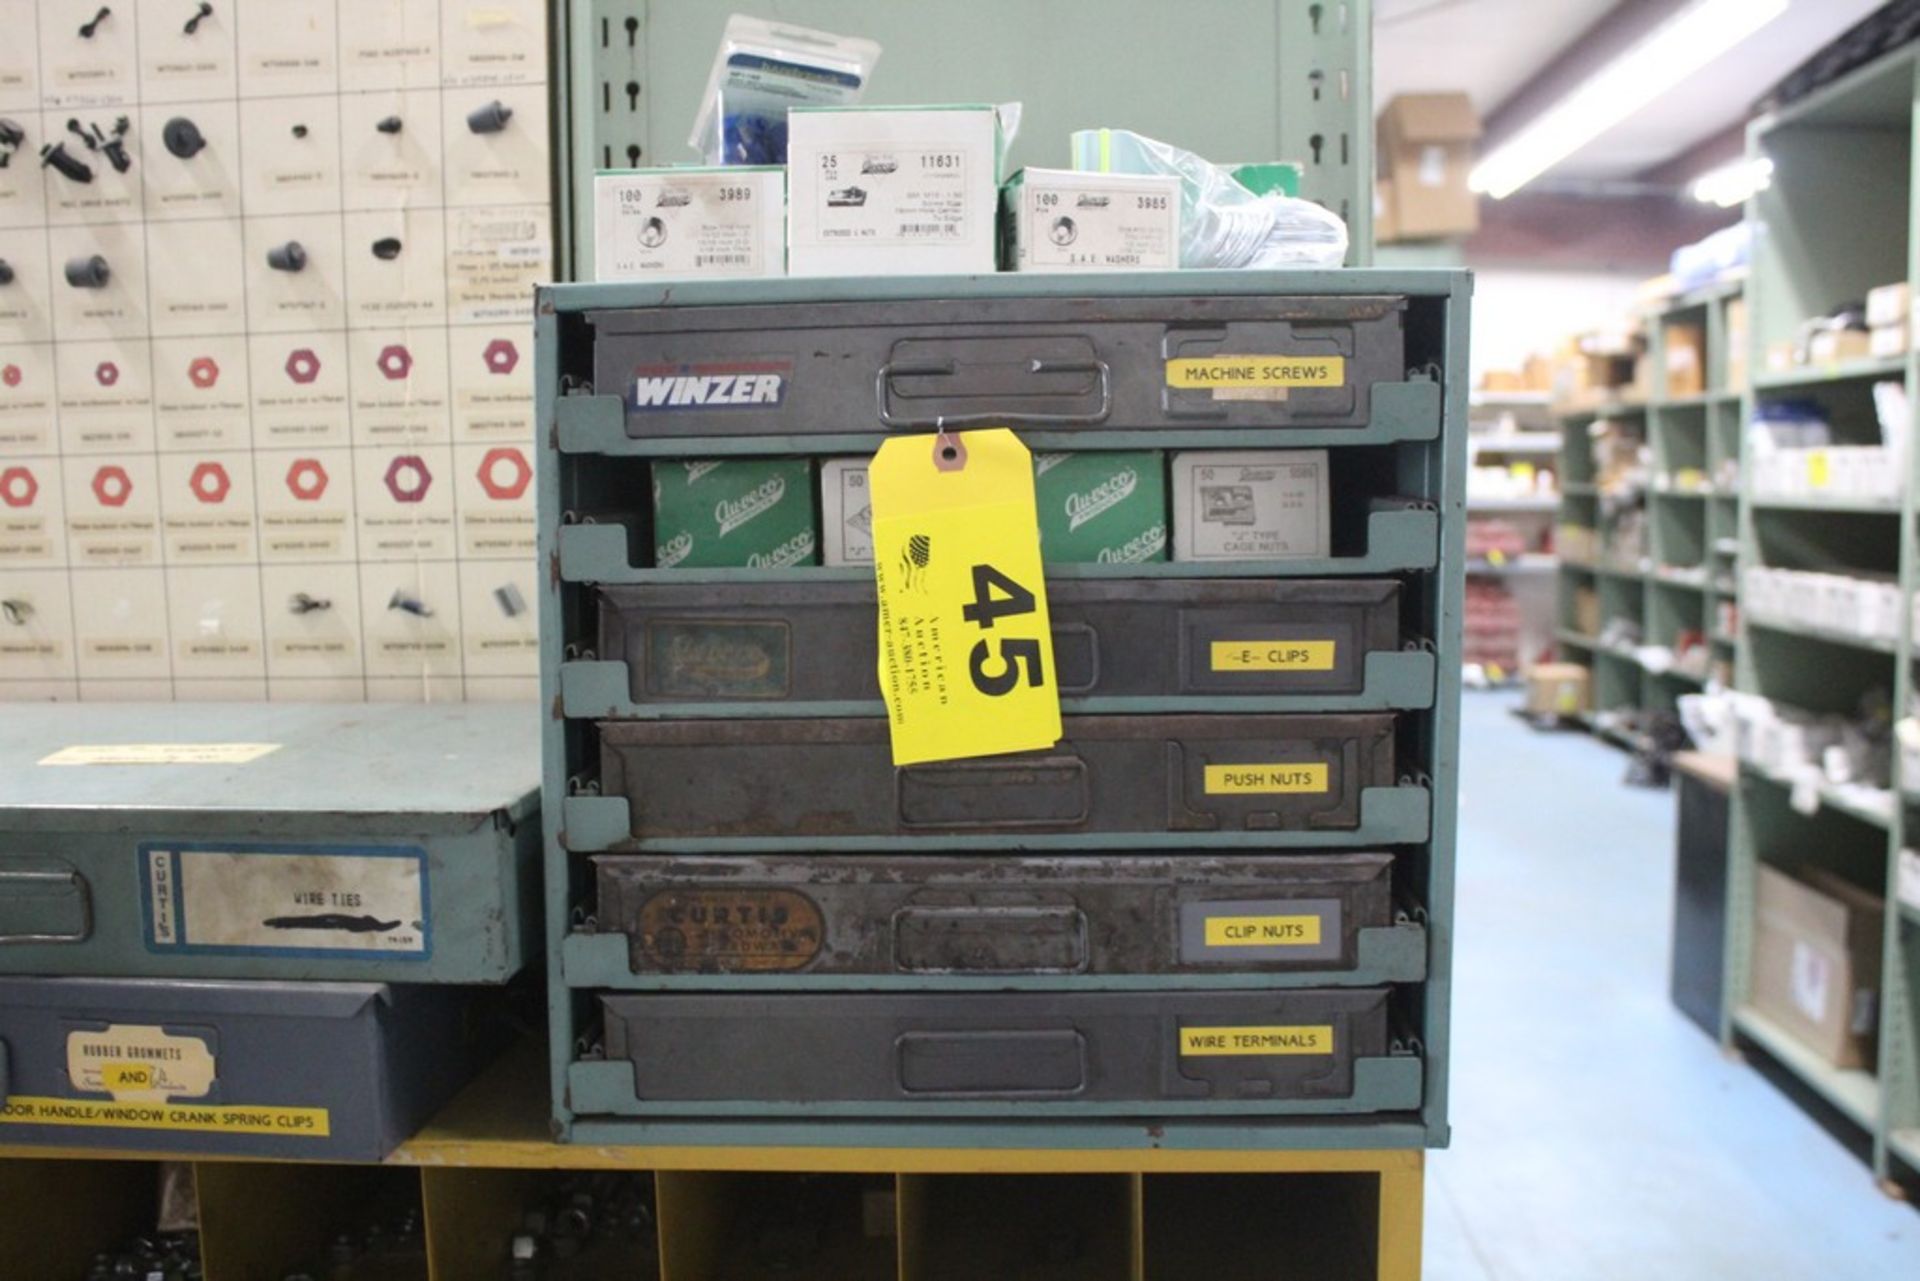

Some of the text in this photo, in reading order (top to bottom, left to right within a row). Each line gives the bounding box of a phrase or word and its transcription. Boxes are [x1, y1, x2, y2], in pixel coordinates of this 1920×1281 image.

[822, 155, 838, 169] 25
[921, 155, 961, 169] 11631
[619, 188, 642, 203] 100
[719, 187, 752, 201] 3989
[1035, 194, 1059, 206] 100
[1136, 196, 1167, 210] 3985
[1184, 365, 1328, 381] MACHINE SCREWS
[636, 374, 781, 406] WINZER
[962, 563, 1044, 697] 45
[877, 562, 905, 725] www.amer-auction.com
[914, 617, 931, 691] Auction
[929, 616, 948, 705] American
[1267, 650, 1310, 663] CLIPS
[1223, 772, 1313, 787] PUSH NUTS
[293, 892, 362, 907] WIRE TIES
[1224, 924, 1304, 939] CLIP NUTS
[1188, 1034, 1317, 1048] WIRE TERMINALS
[82, 1044, 122, 1057] RUBBER
[119, 1070, 148, 1083] AND
[39, 1106, 165, 1122] HANDLE/WINDOW
[169, 1110, 218, 1125] CRANK
[222, 1112, 272, 1127] SPRING
[276, 1114, 315, 1129] CLIPS
